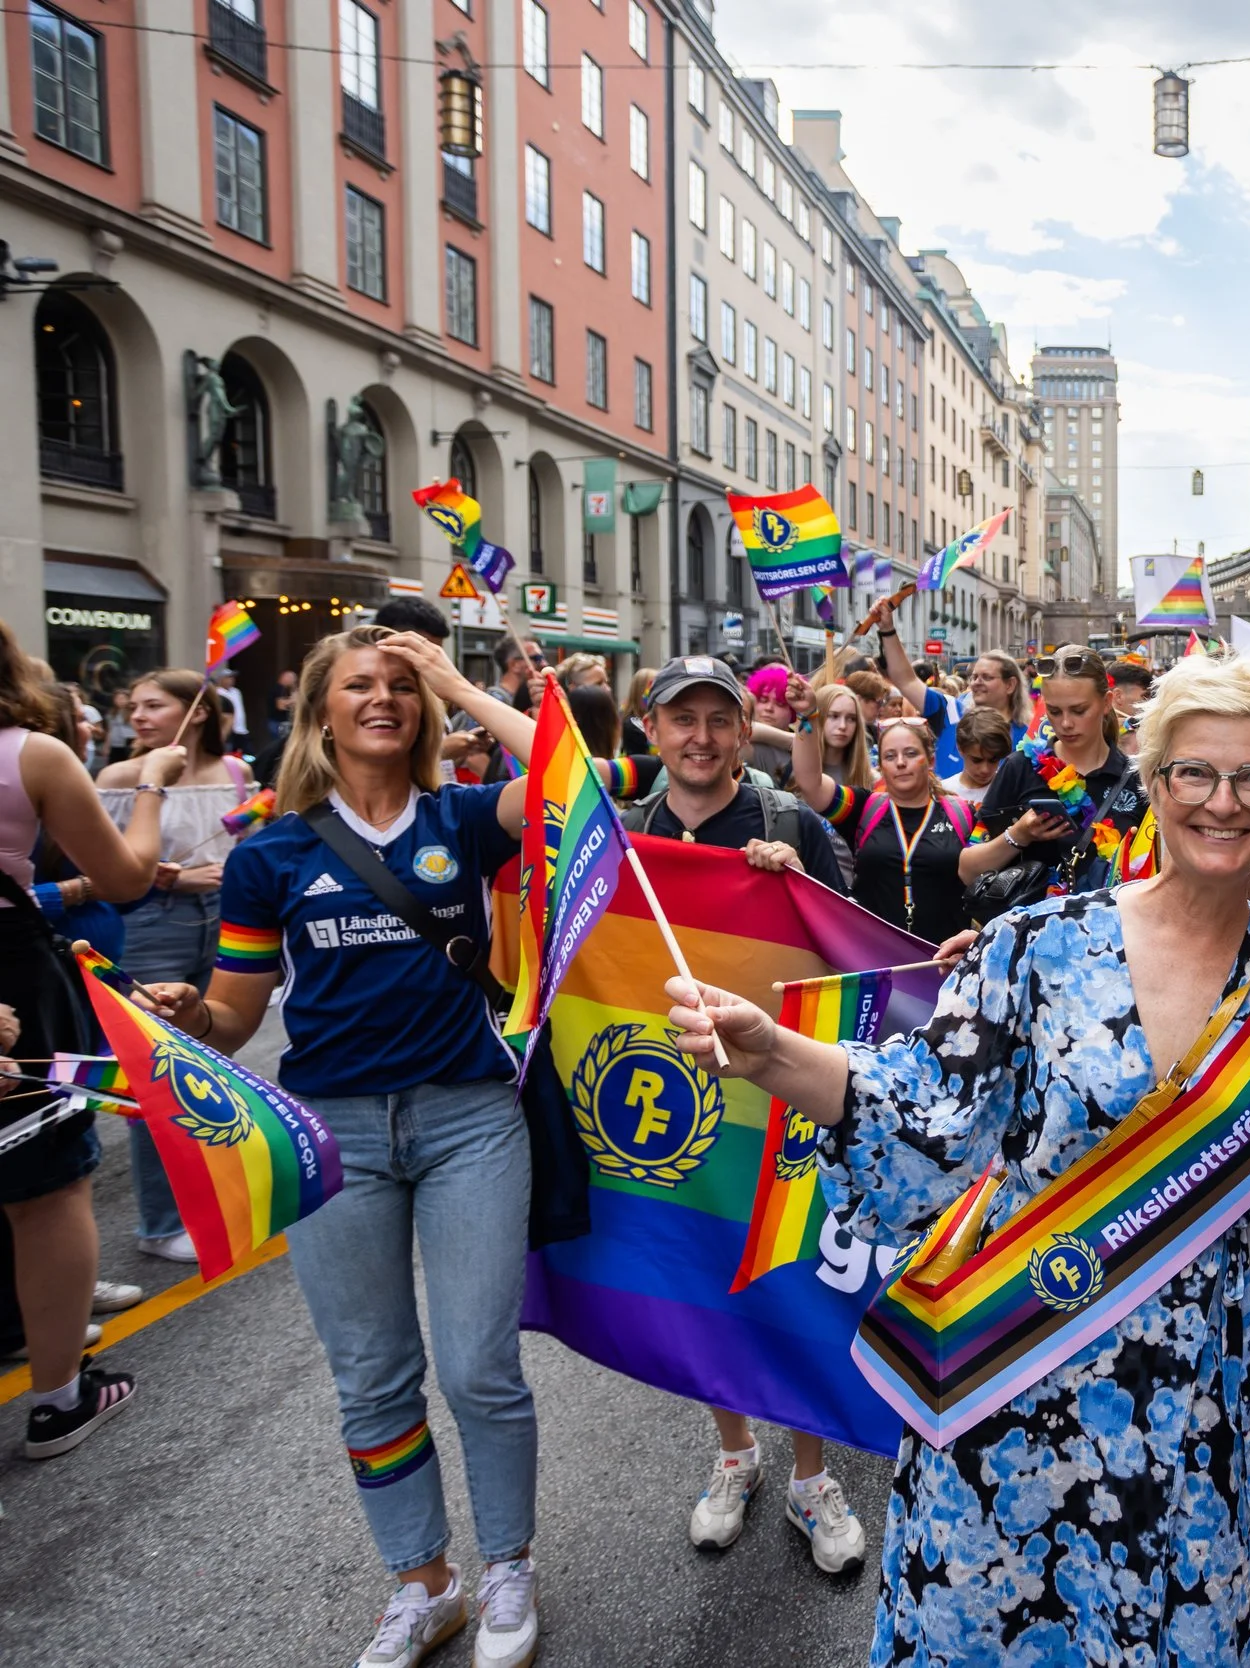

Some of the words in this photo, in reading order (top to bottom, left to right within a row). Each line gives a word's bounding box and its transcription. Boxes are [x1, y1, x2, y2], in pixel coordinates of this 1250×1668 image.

[817, 559, 838, 573] GÖR
[46, 606, 152, 631] CONVENDUM
[341, 925, 421, 947] Stockhol
